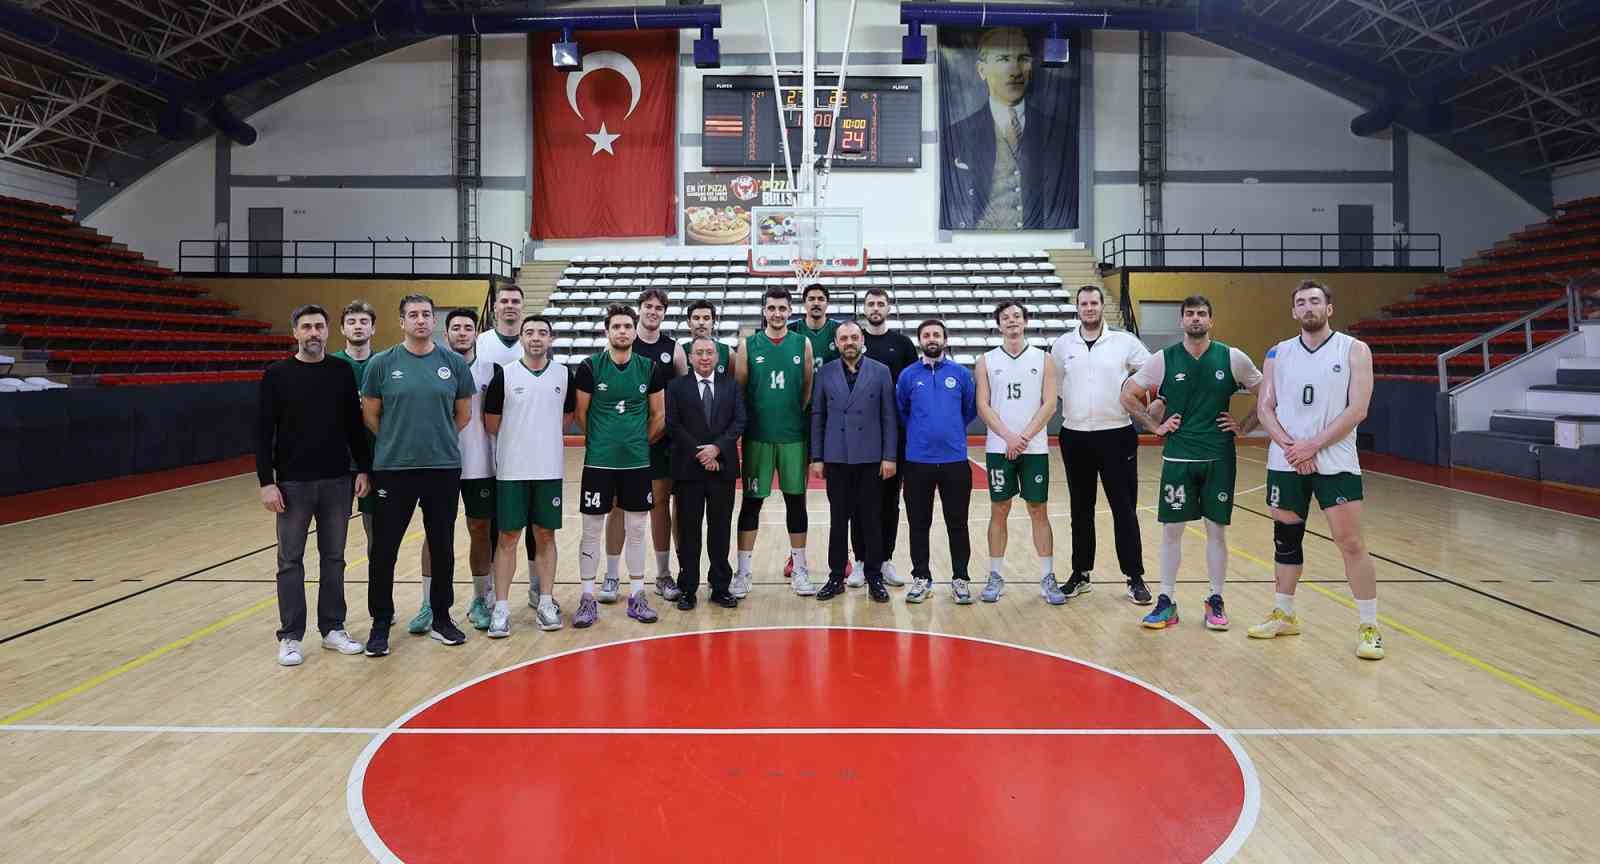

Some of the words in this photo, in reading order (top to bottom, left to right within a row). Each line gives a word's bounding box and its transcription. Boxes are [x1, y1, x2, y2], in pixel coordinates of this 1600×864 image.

[843, 119, 866, 128] 10:00
[842, 131, 864, 149] 24
[762, 191, 793, 205] BULLS
[770, 370, 785, 389] 14
[1007, 383, 1022, 399] 15
[1303, 386, 1314, 404] 0
[615, 400, 625, 414] 4
[990, 468, 1005, 486] 15
[584, 491, 601, 508] 54
[1164, 484, 1186, 503] 34
